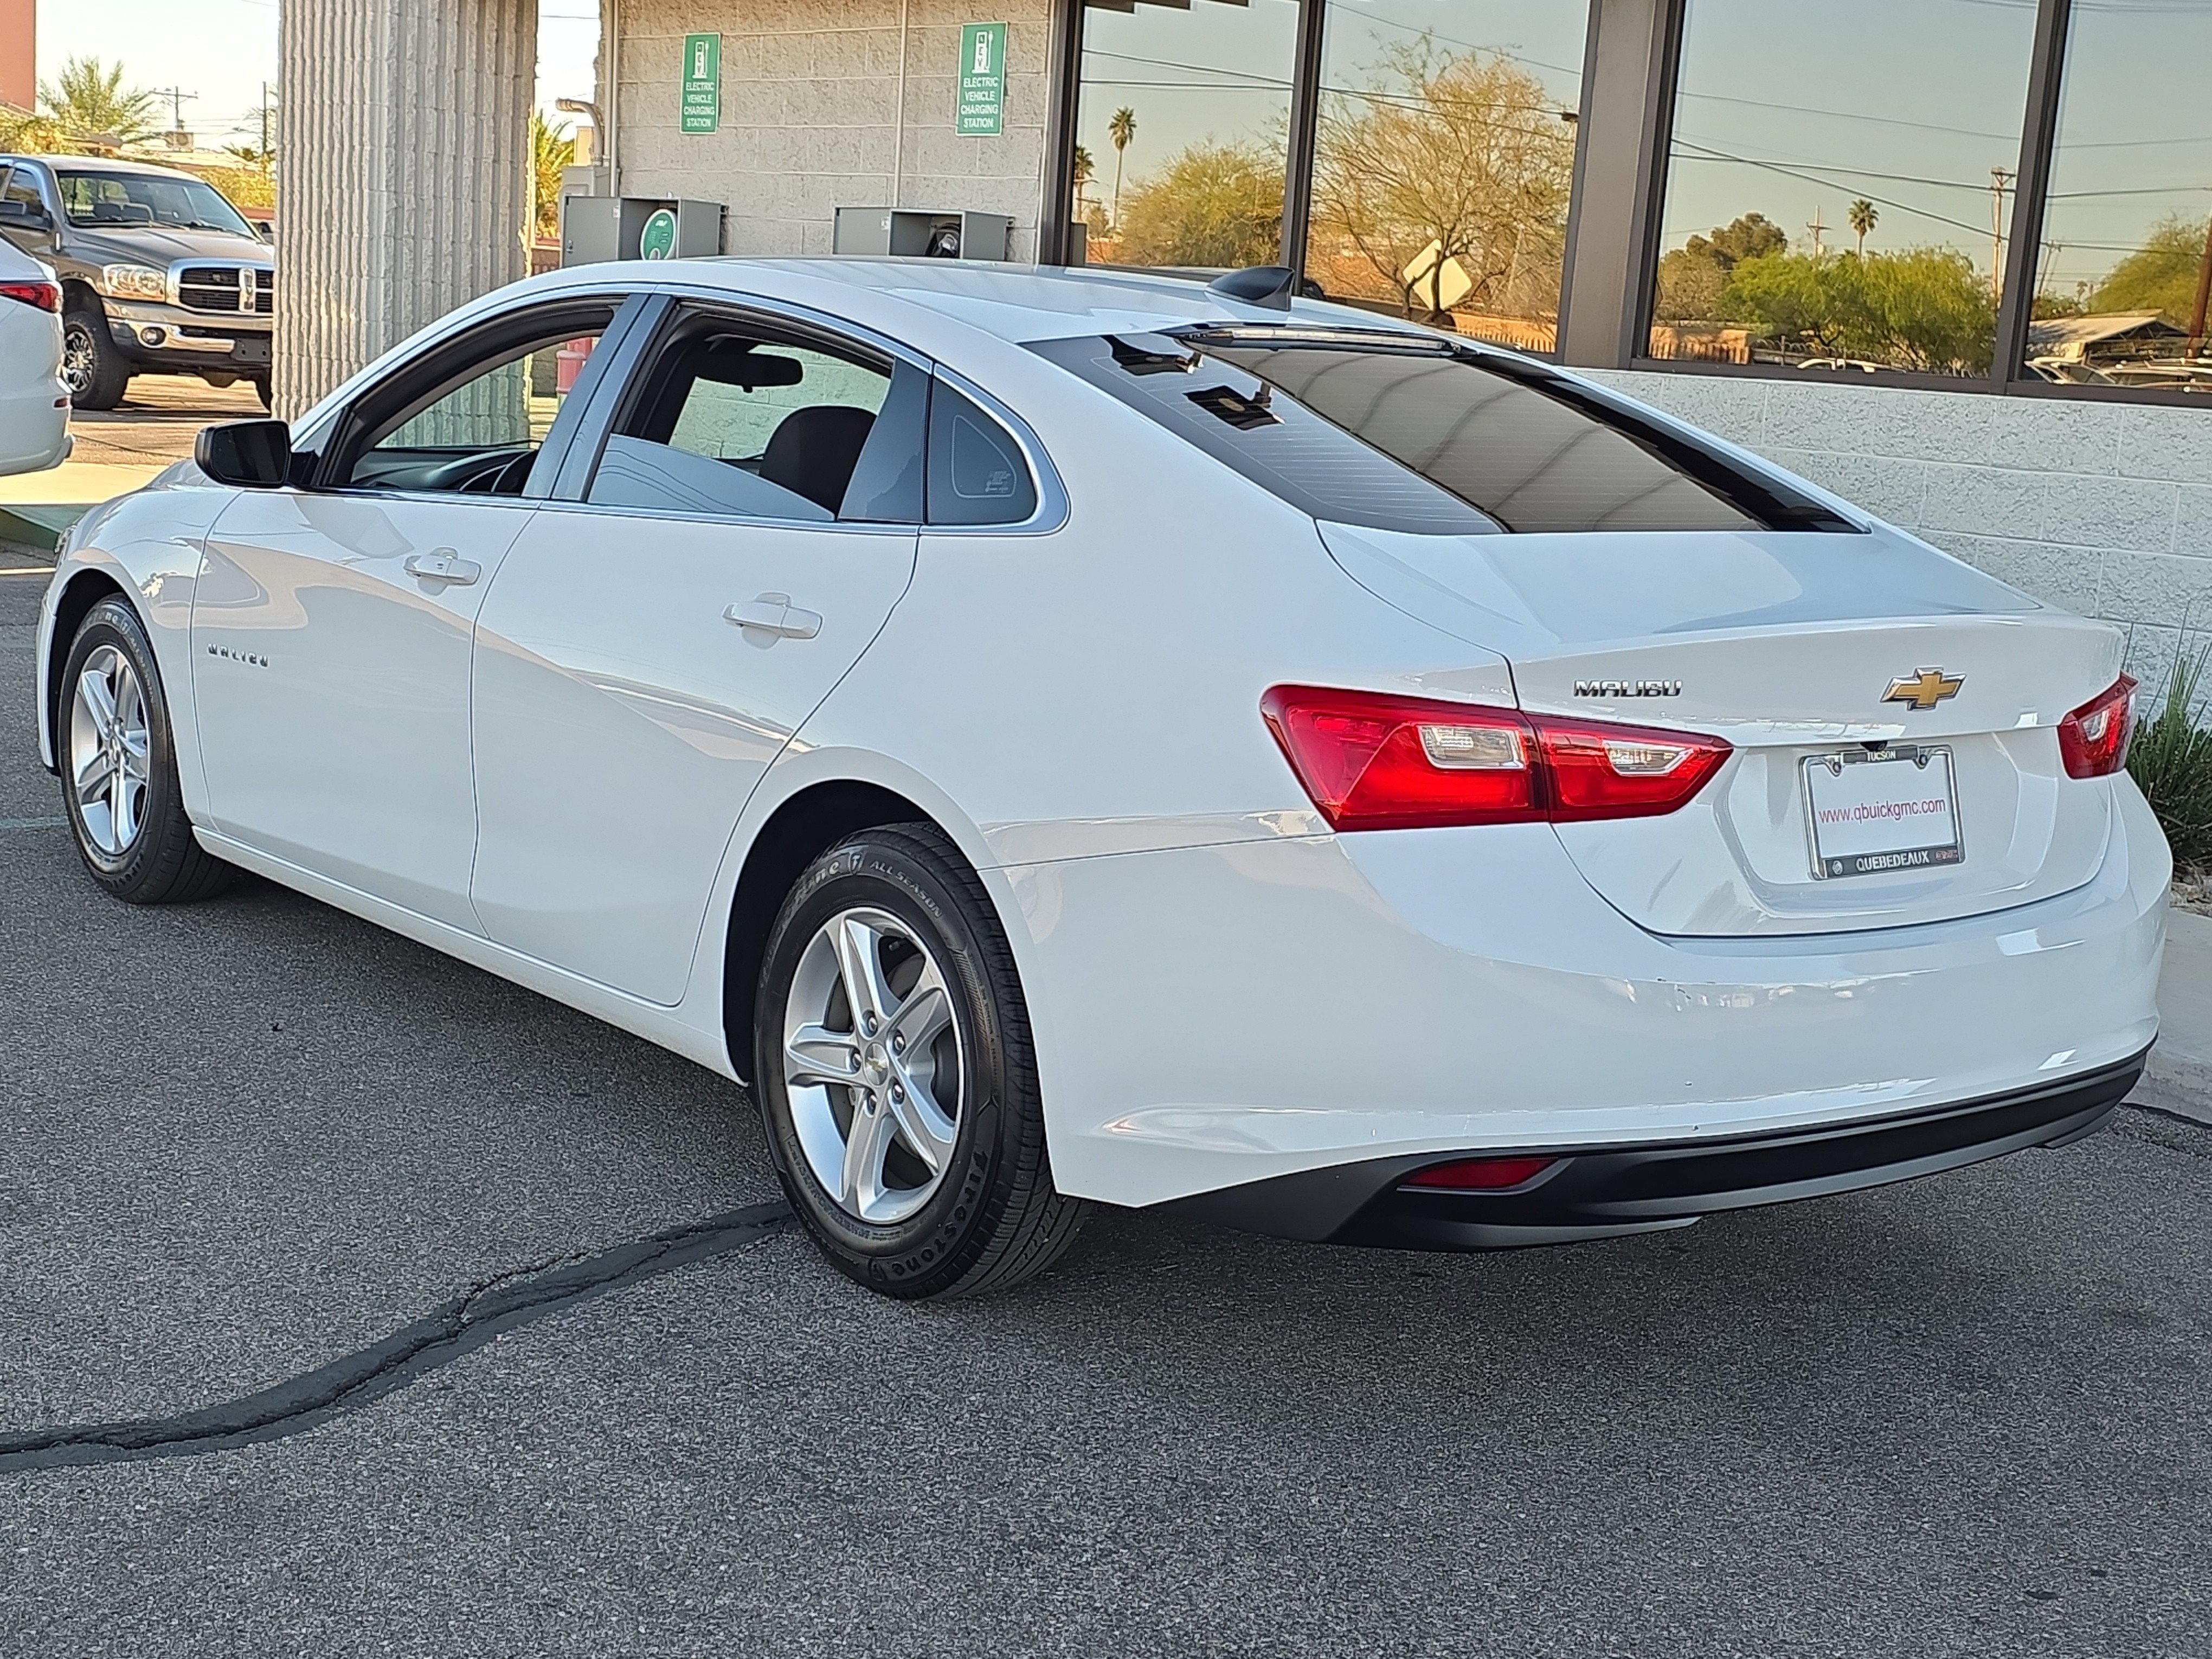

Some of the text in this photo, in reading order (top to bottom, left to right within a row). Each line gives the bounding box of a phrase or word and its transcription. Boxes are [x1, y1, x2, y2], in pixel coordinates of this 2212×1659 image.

[686, 82, 714, 91] ELECTRIC
[963, 77, 999, 88] ELECTRIC
[687, 94, 712, 103] VEHICLE
[964, 91, 995, 101] VEHICLE
[684, 105, 715, 115] CHARGING
[961, 104, 999, 115] CHARGING
[686, 117, 711, 127] STATION
[963, 118, 994, 128] STATION
[208, 643, 268, 668] MALIBU
[1574, 680, 1682, 698] MALIBU
[1867, 750, 1896, 762] TUCSON
[1819, 799, 1946, 824] www.qbuickgmc.com
[1856, 851, 1930, 872] QUEBEDEAUX
[870, 860, 893, 875] ALL
[895, 871, 943, 918] SEASON
[891, 1150, 988, 1277] Firestone
